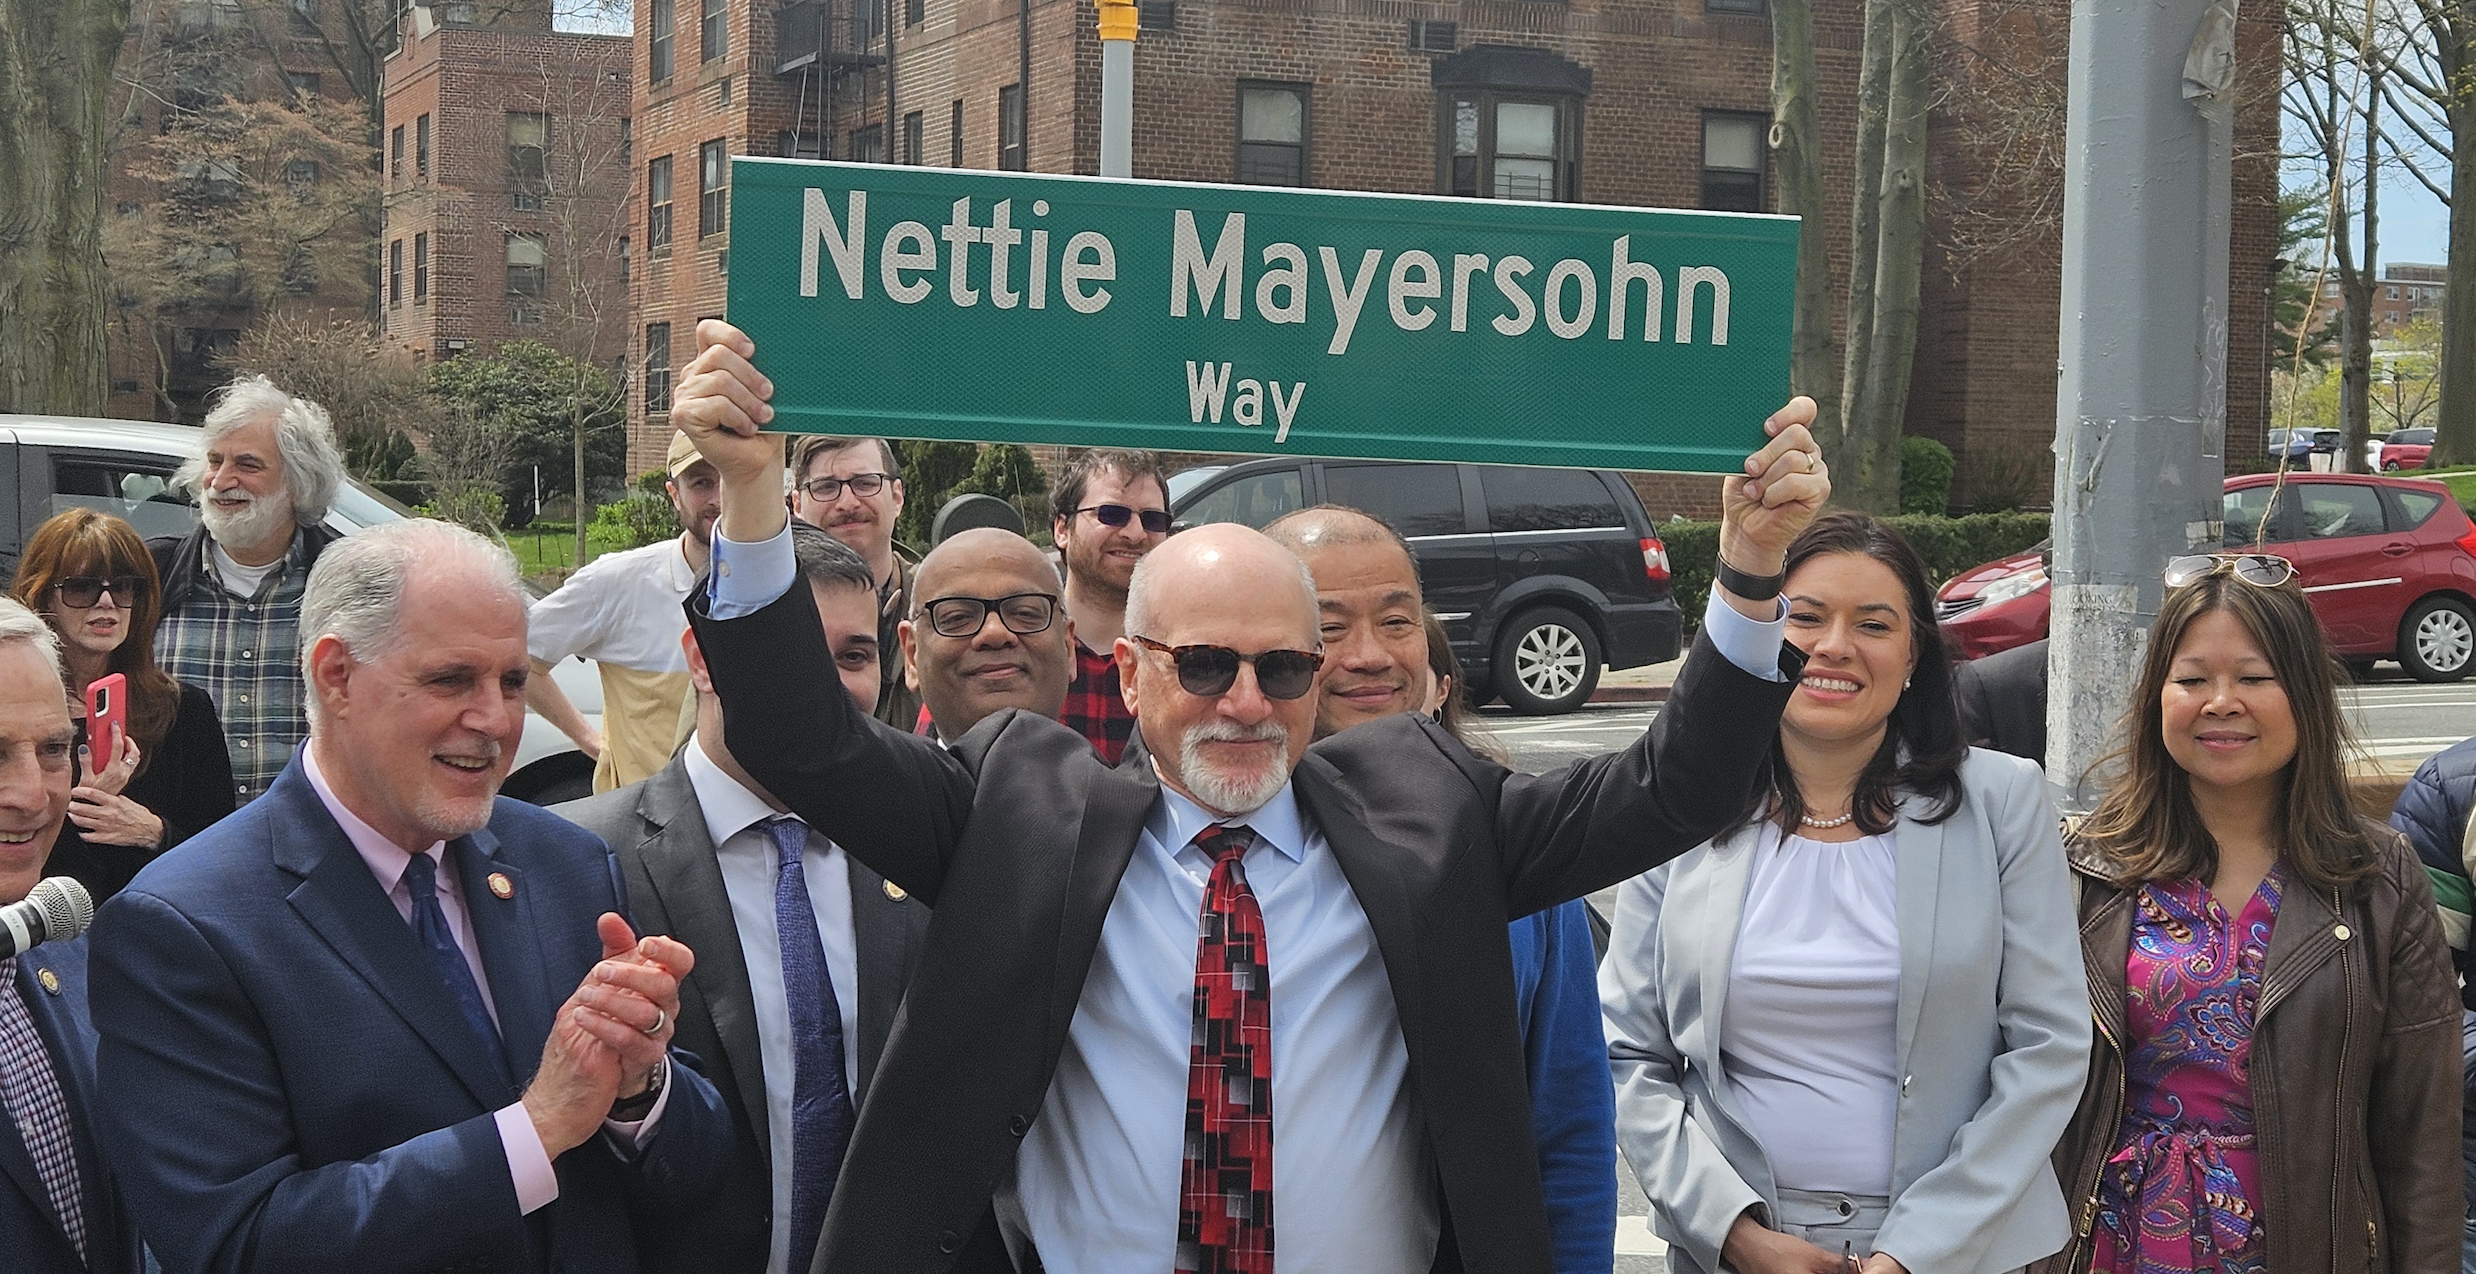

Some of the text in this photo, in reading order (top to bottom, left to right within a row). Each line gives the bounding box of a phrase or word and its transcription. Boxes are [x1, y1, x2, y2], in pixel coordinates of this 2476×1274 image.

[800, 188, 1731, 356] Nettie Mayersohn
[1186, 361, 1307, 444] Way
